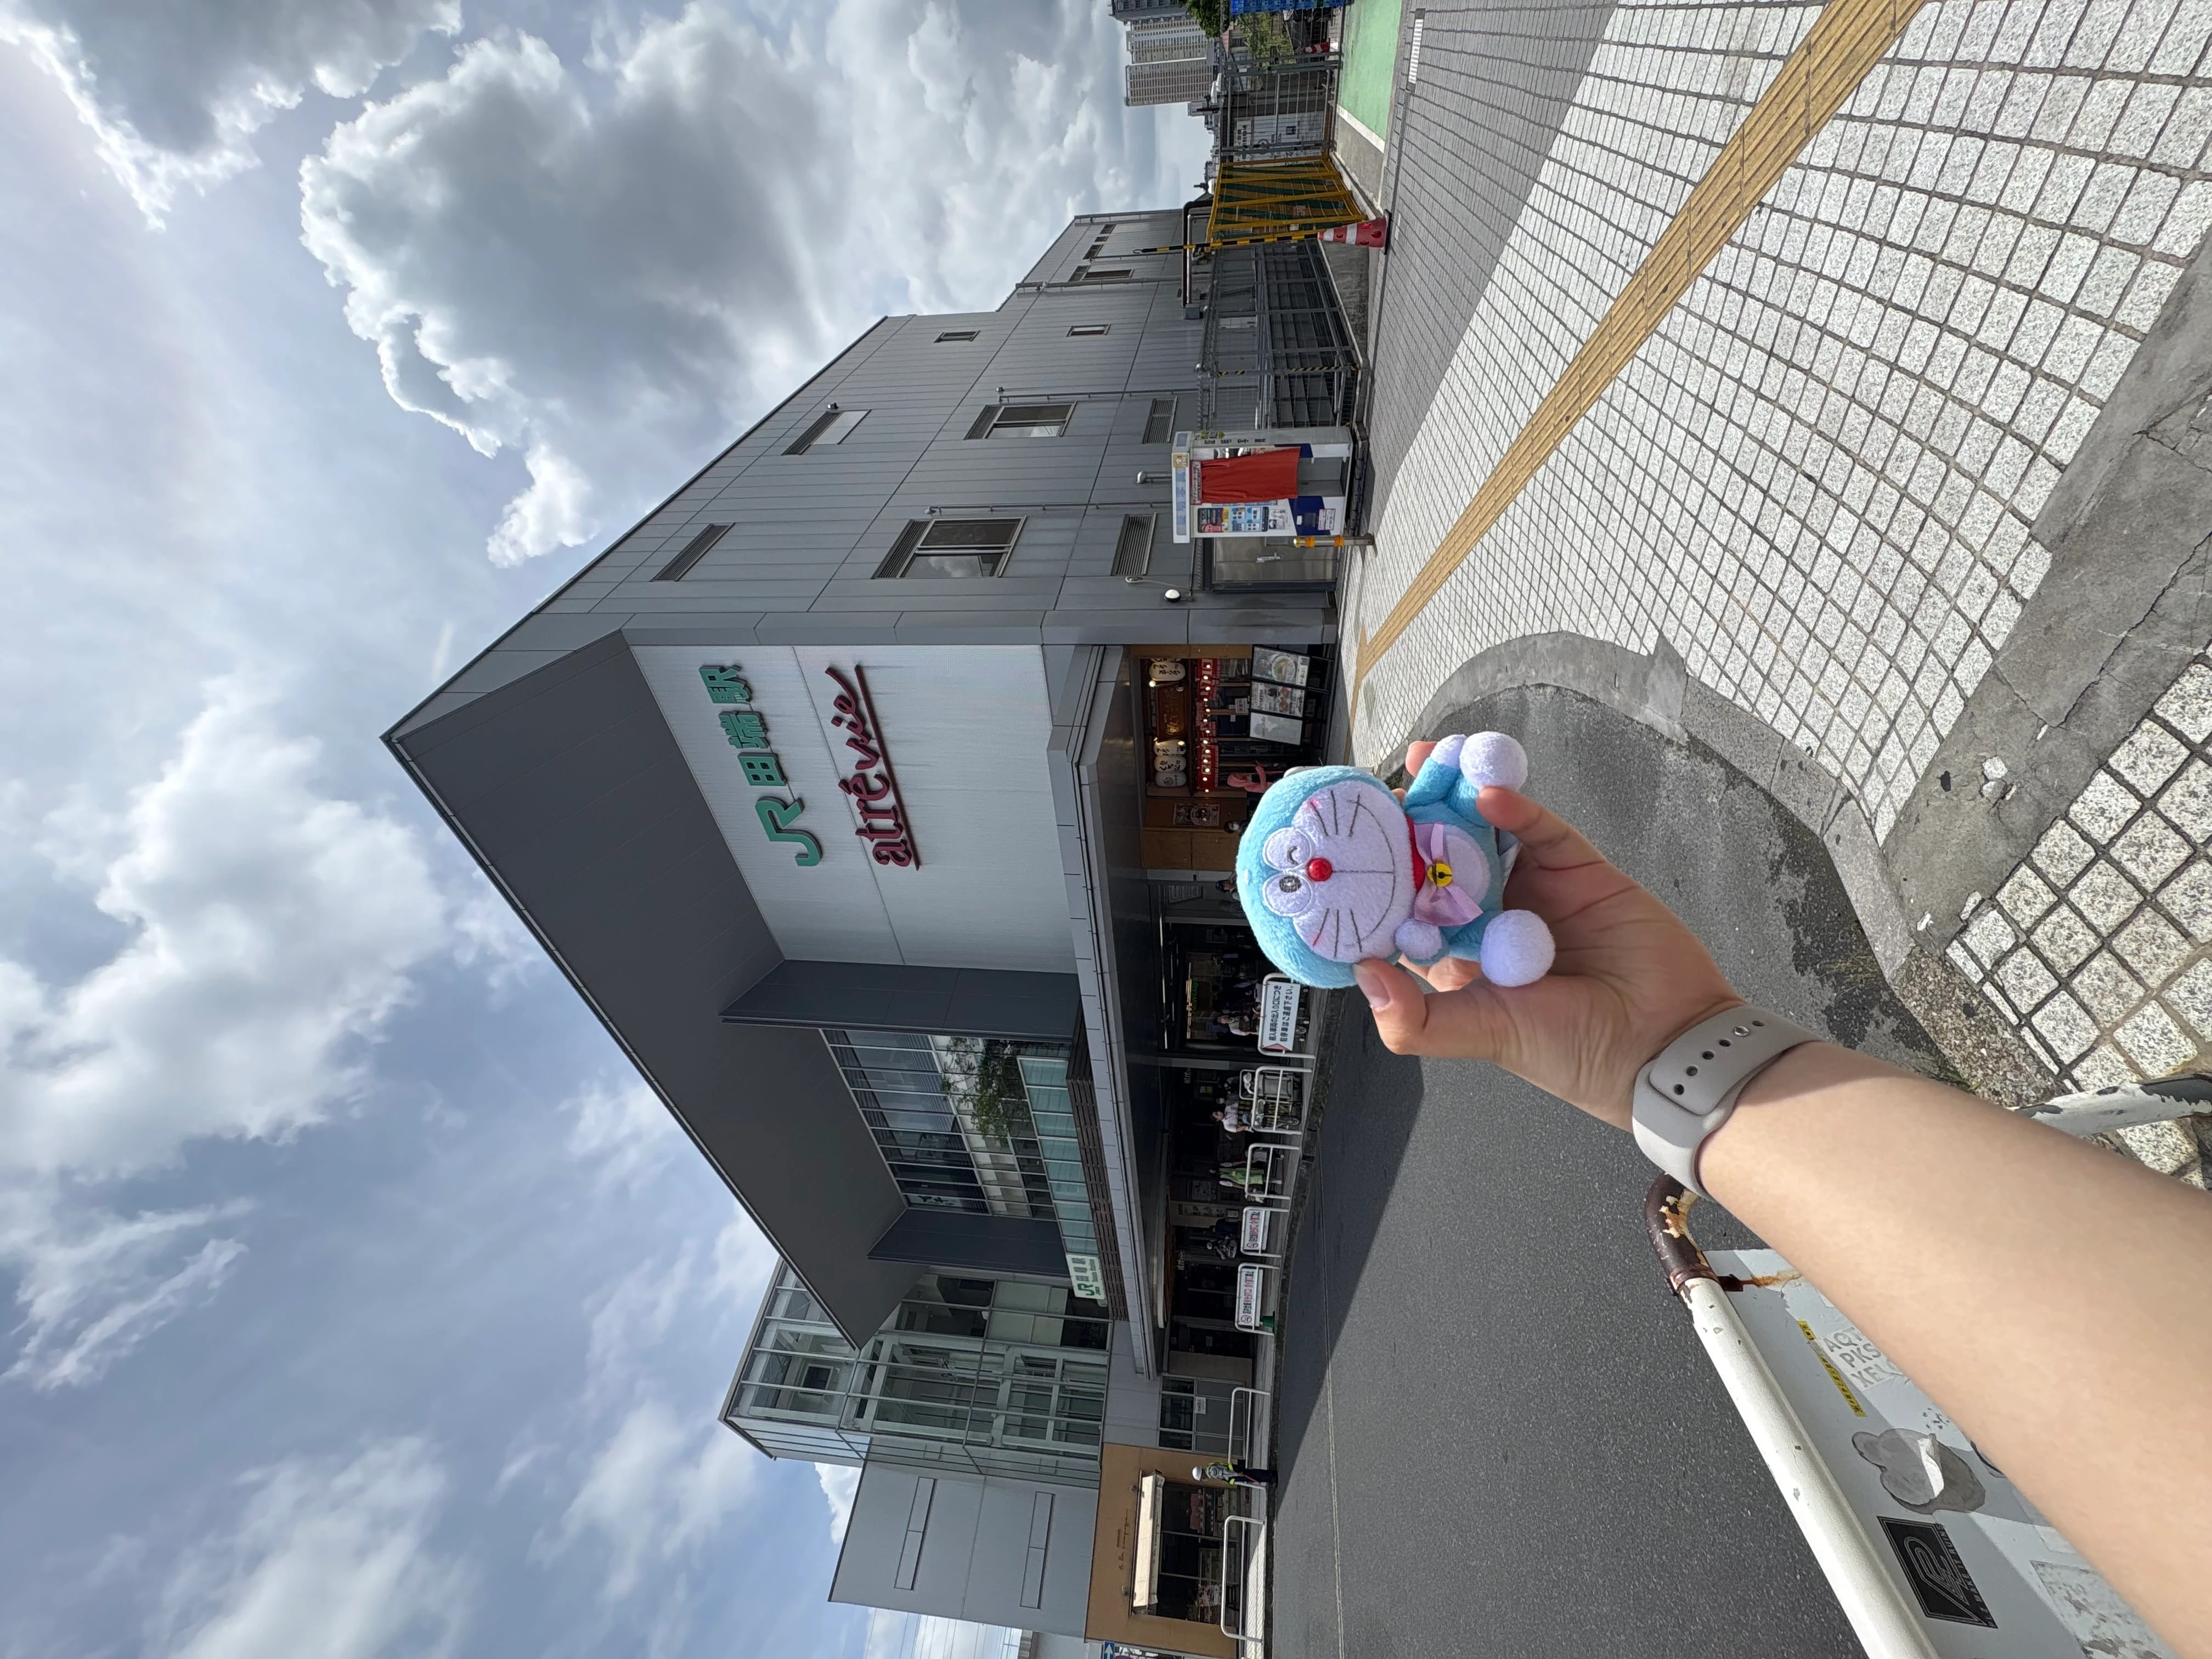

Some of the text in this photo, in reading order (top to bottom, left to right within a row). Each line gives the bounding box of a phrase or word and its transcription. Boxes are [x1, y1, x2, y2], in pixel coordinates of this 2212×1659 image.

[698, 665, 822, 866] JR田端駅
[1936, 1523, 1995, 1627] PLZ MAKE IT RUINS
